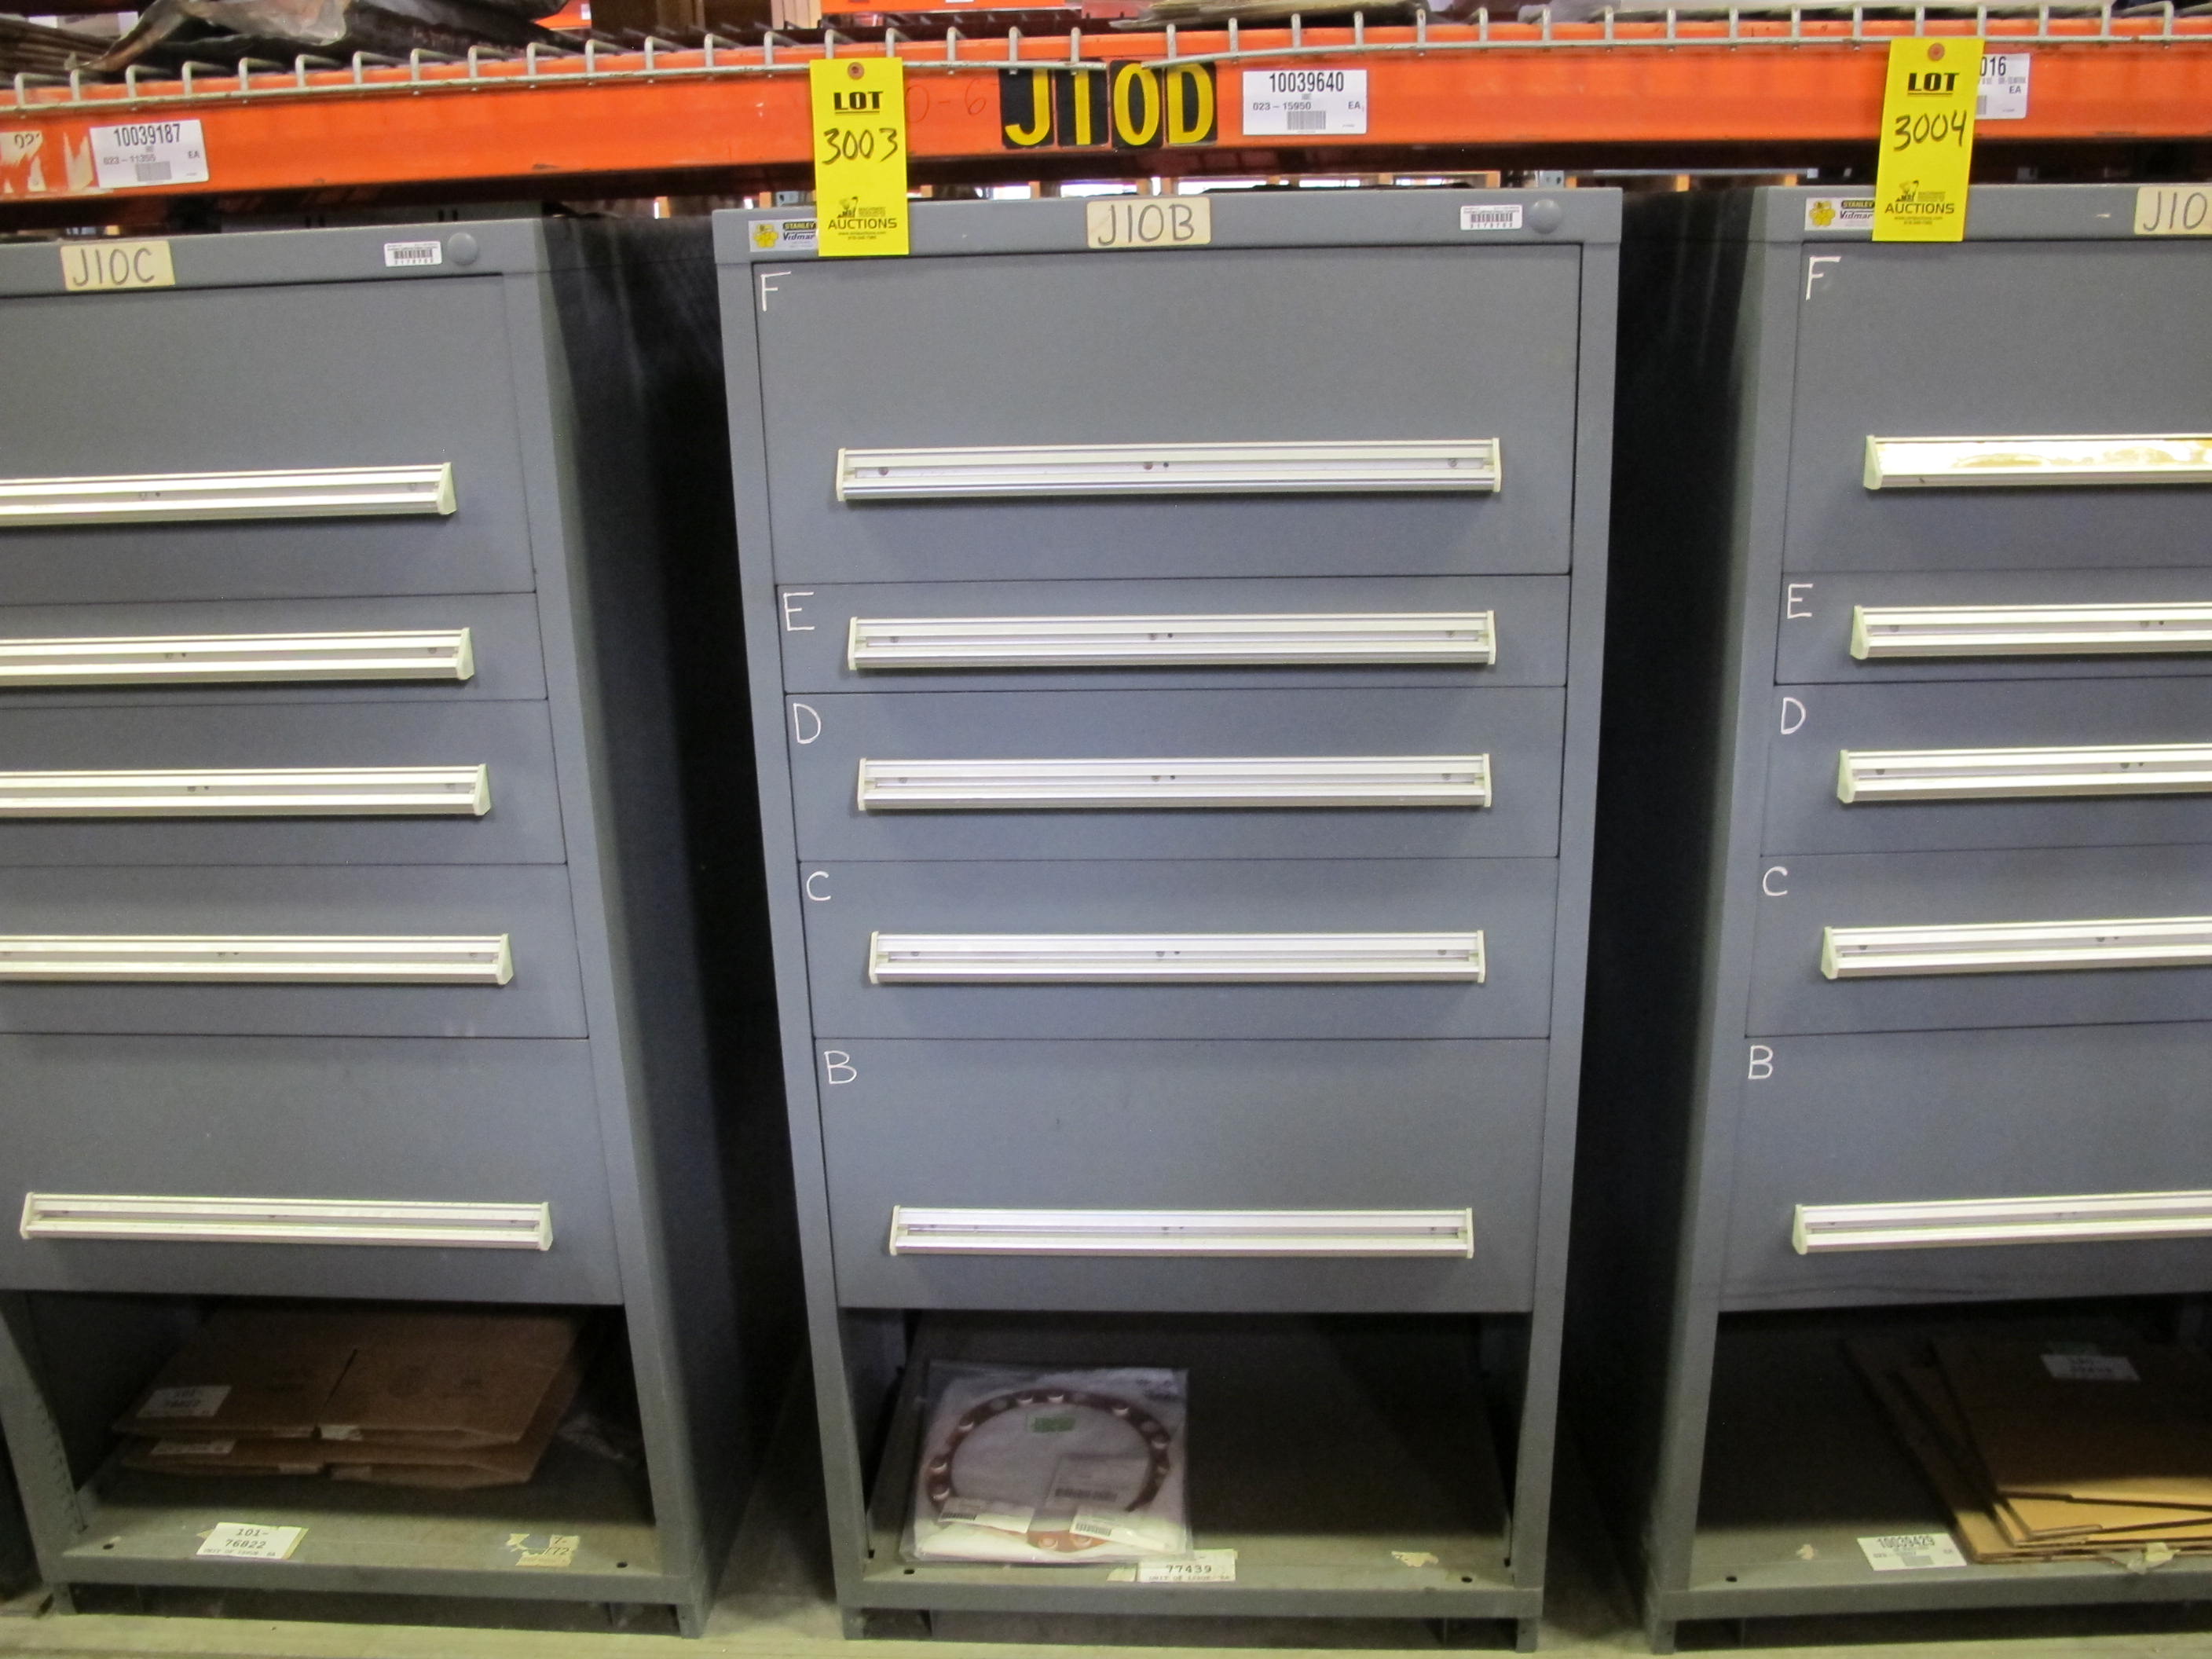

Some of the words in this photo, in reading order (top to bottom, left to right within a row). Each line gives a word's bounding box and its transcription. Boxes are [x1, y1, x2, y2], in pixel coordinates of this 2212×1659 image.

[1269, 71, 1344, 93] 10039640
[1907, 73, 1959, 92] LOT
[833, 91, 883, 110] LOT
[1005, 62, 1214, 145] J10D
[113, 123, 180, 146] 10039187
[822, 128, 898, 165] 3003
[1894, 110, 1967, 151] 3004
[828, 218, 897, 229] AUCTIONS
[1098, 204, 1195, 246] J10B
[1840, 211, 1873, 219] Vidmar
[1885, 203, 1954, 214] AUCTIONS
[783, 232, 815, 240] Vidmar
[73, 248, 155, 286] J10C
[1806, 256, 1841, 301] F
[760, 271, 792, 312] F
[783, 591, 815, 631] E
[1787, 584, 1813, 619] E
[793, 703, 821, 744] D
[1781, 697, 1806, 734] D
[807, 871, 831, 902] C
[1763, 866, 1788, 896] C
[824, 1050, 857, 1084] B
[1748, 1045, 1773, 1079] B
[236, 1528, 269, 1537] 101-
[1166, 1564, 1212, 1573] 77439
